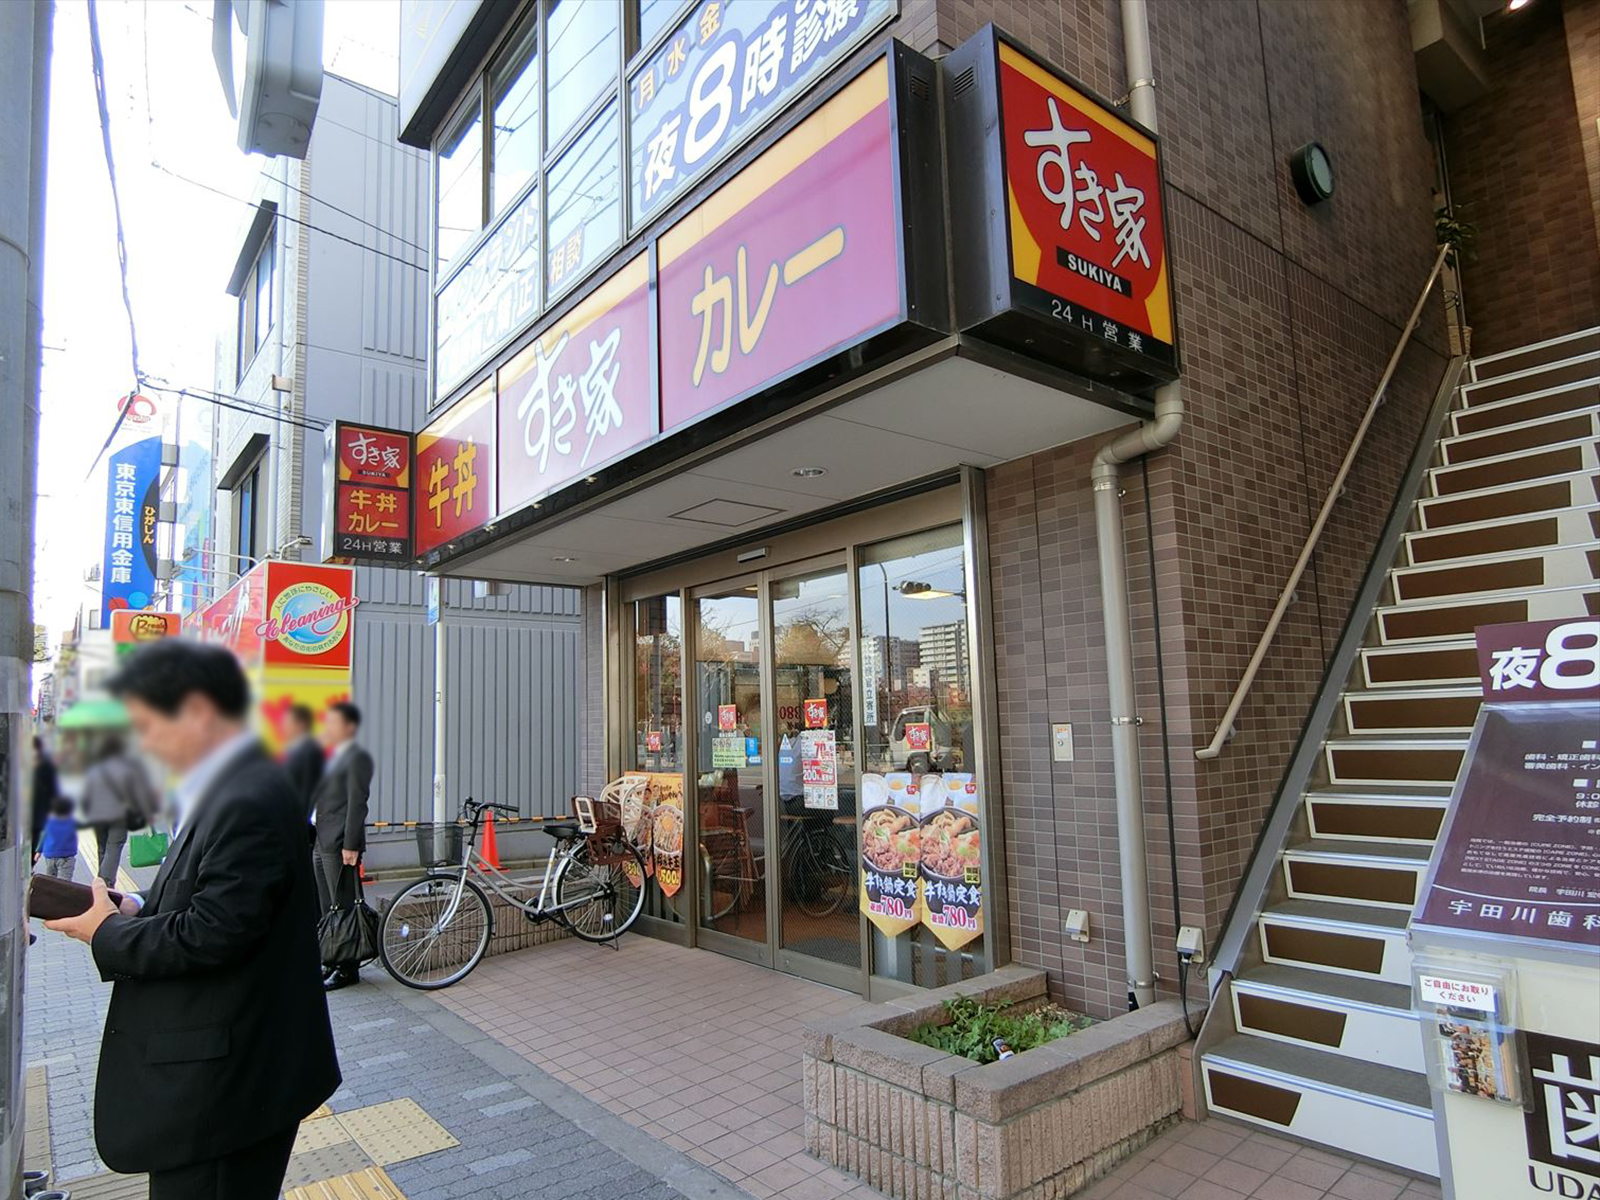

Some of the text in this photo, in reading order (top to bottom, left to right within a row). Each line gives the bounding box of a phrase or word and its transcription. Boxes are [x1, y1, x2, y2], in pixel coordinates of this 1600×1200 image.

[1024, 97, 1150, 269] すき家
[551, 230, 582, 286] 相談
[1067, 254, 1122, 293] SUKIYA
[691, 225, 845, 387] カレー
[517, 327, 623, 473] すき家
[348, 432, 401, 472] すき家
[427, 435, 478, 527] 牛丼
[350, 490, 398, 513] 牛丼
[111, 463, 137, 584] 東京東信用金庫
[143, 506, 156, 543] ひがしん
[348, 511, 399, 533] カレー
[343, 537, 402, 554] 24H営業
[256, 597, 360, 640] Cleaning
[1532, 814, 1592, 824] 完全予約制
[865, 871, 917, 898] 牛すき鍋定食
[924, 880, 981, 906] 牛すき鍋定食
[1448, 899, 1600, 930] 宇田川歯科
[1424, 979, 1488, 996] ご自由にお取り
[1439, 991, 1476, 1003] ください
